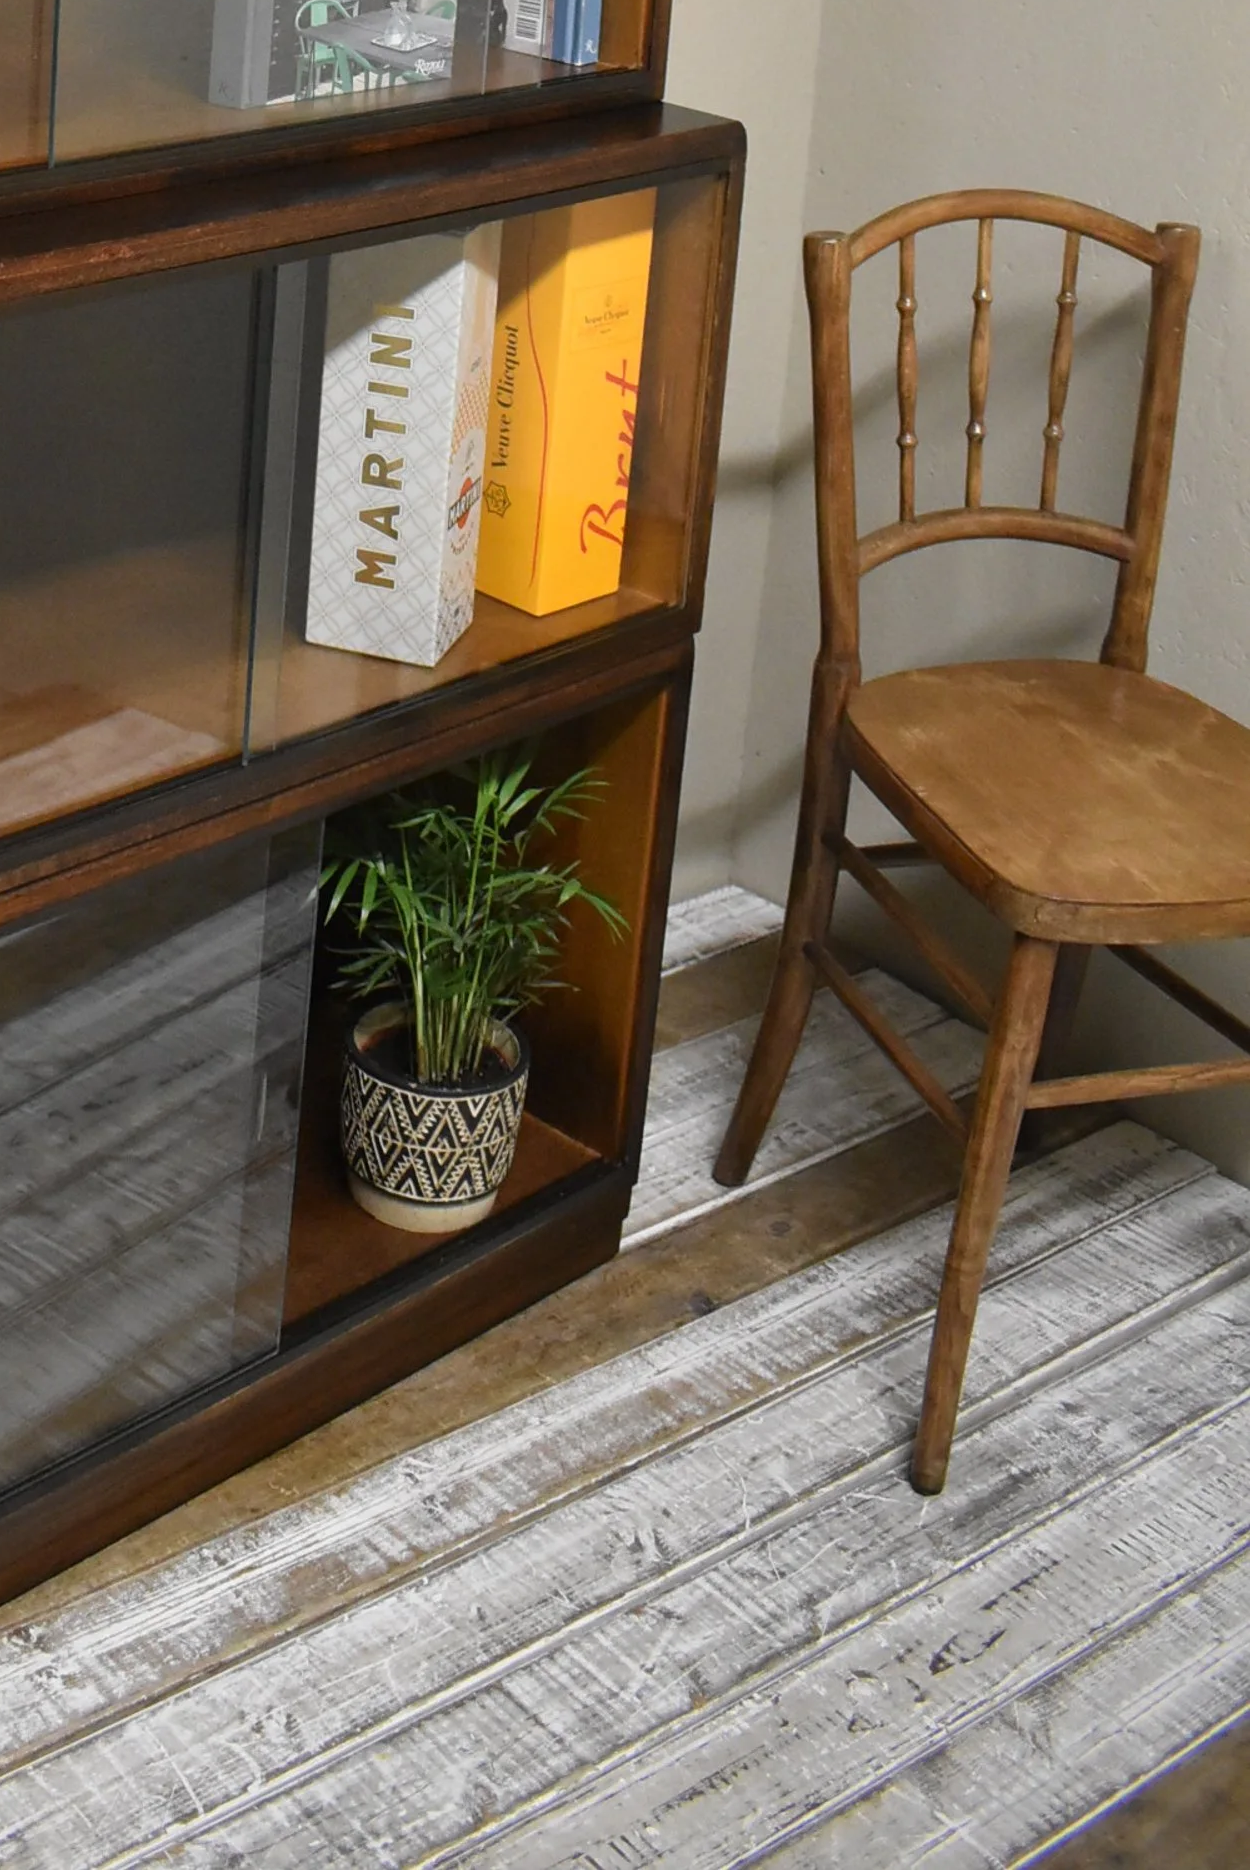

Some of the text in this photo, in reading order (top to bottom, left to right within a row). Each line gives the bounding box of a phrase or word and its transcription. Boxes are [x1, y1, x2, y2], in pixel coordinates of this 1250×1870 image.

[354, 304, 415, 590] MARTINI
[491, 325, 520, 467] Veuve Clicquot
